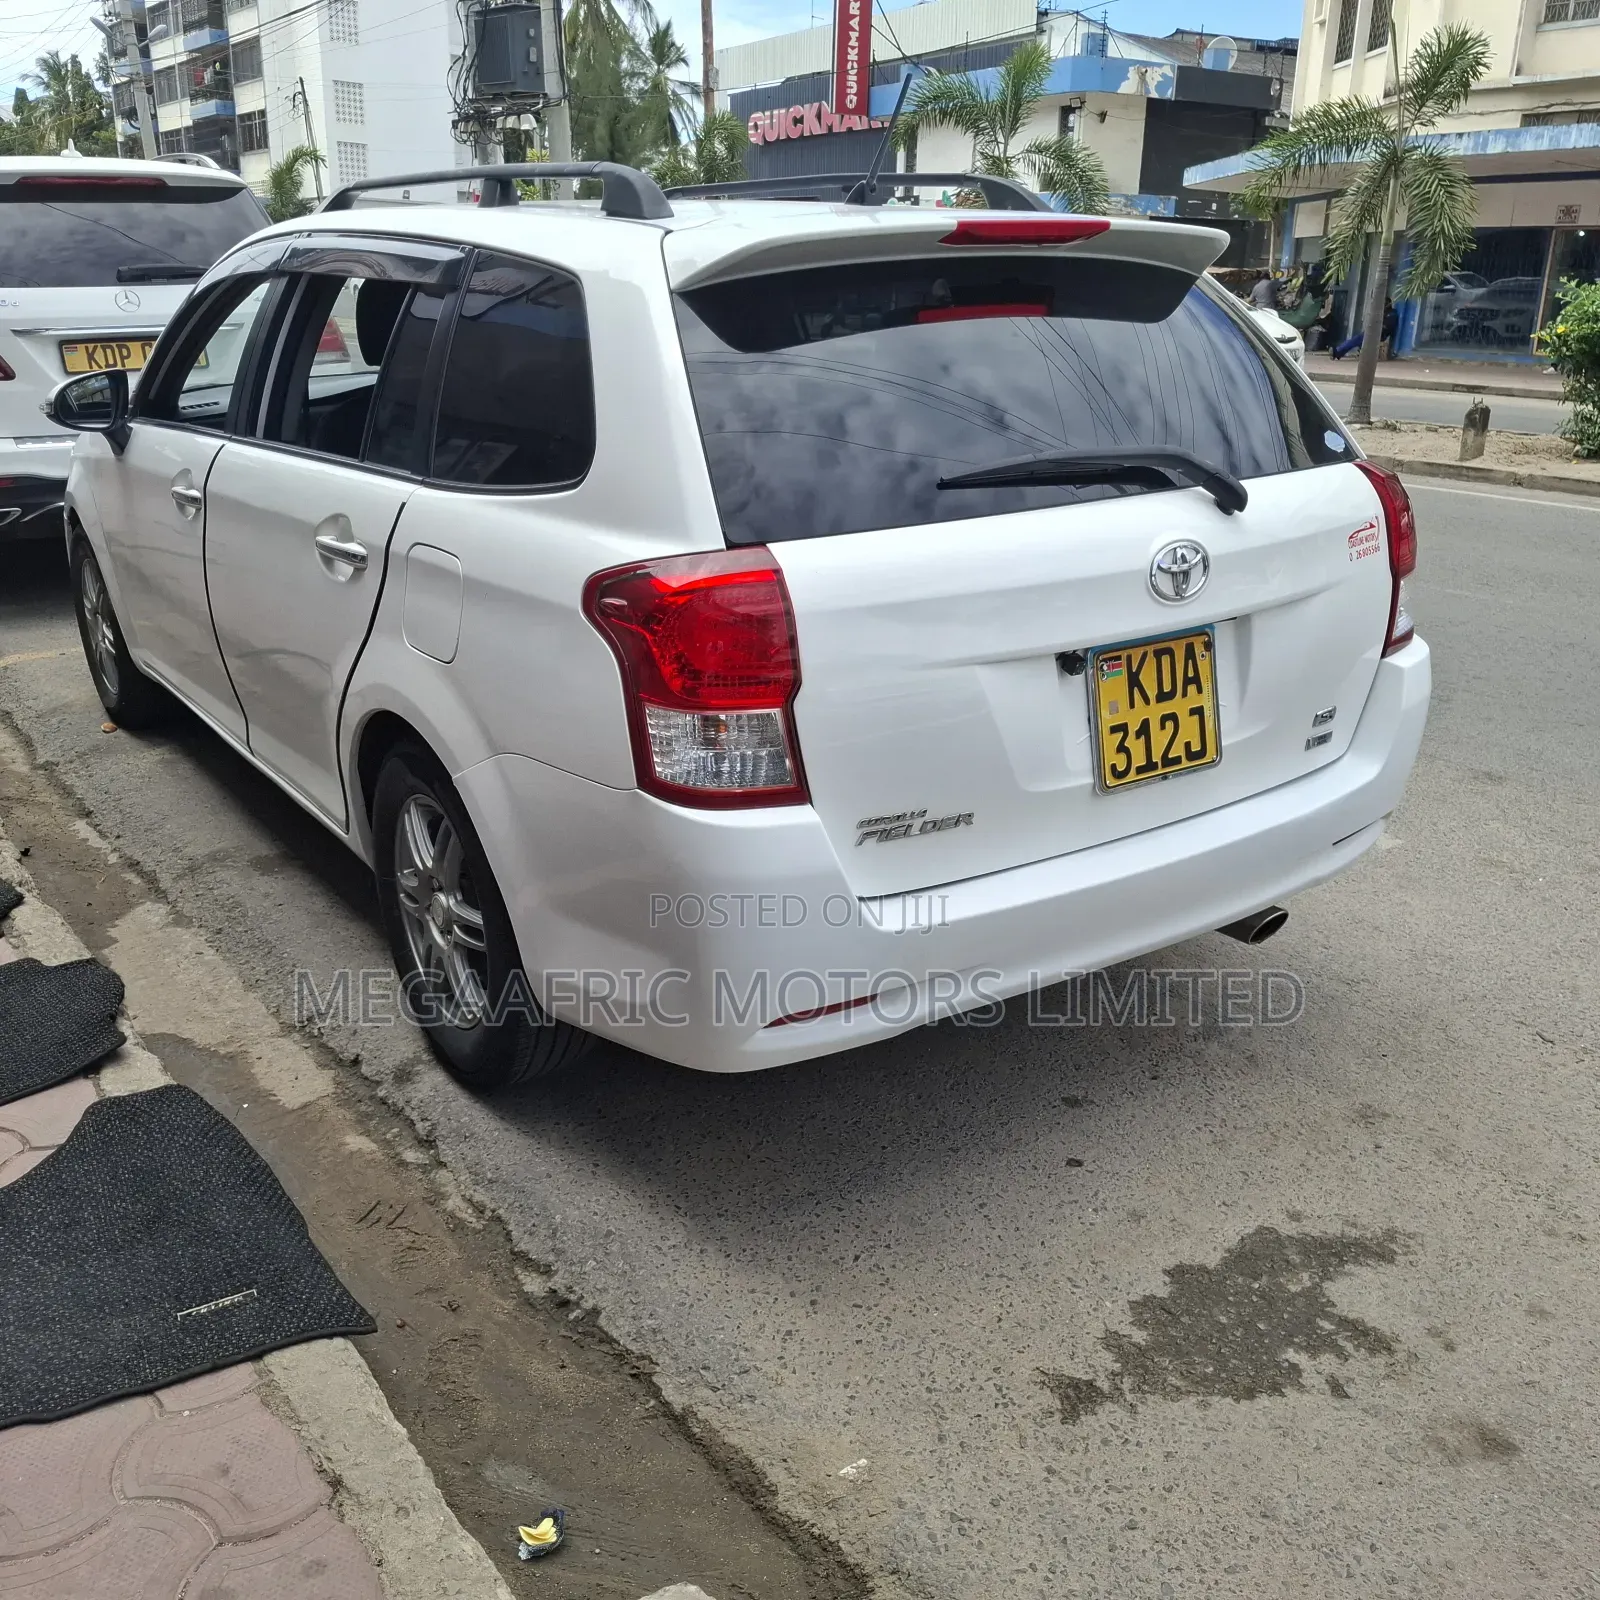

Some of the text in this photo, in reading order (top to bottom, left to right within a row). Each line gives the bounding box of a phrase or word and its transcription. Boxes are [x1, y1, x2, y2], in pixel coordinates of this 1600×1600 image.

[845, 0, 861, 110] QUICKMAR
[85, 342, 131, 370] KDP
[1126, 641, 1203, 710] KDA
[1109, 705, 1208, 780] 312J
[854, 812, 975, 847] FIELDER
